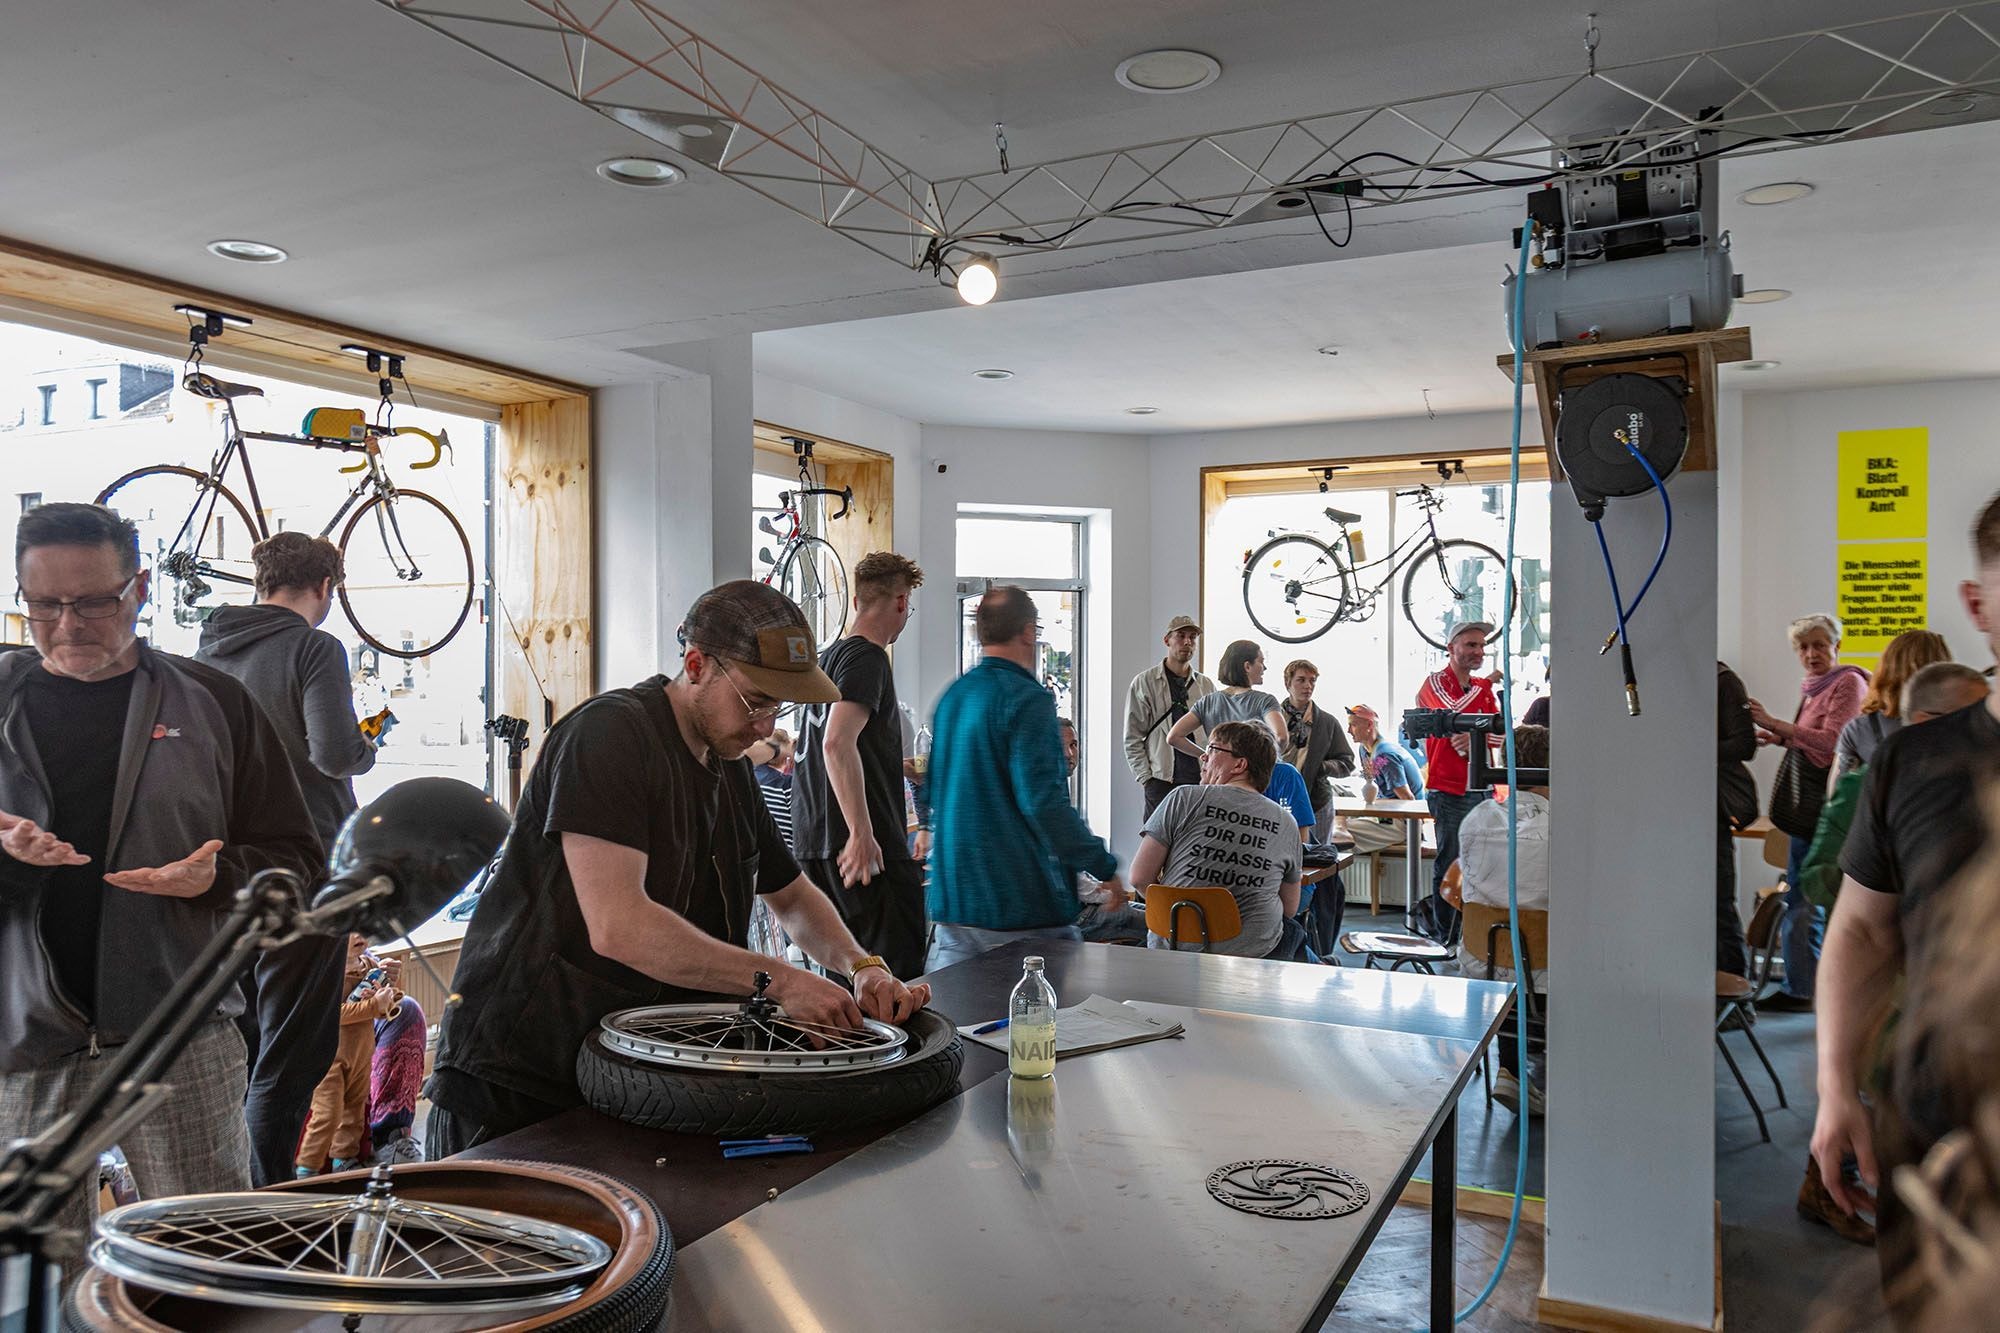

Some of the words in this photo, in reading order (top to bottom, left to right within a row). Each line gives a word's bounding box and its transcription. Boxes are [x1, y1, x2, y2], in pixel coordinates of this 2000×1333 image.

[1867, 457, 1899, 470] BKA:
[1867, 472, 1898, 484] Blatt
[1856, 485, 1909, 498] Kontroll
[1869, 501, 1896, 512] Amt
[1845, 561, 1860, 570] Die
[1862, 560, 1921, 569] Menschheit
[1842, 572, 1867, 581] stellt
[1870, 572, 1890, 580] sich
[1893, 571, 1923, 580] schon
[1853, 583, 1885, 592] immer
[1881, 594, 1897, 602] Die
[1847, 628, 1860, 637] ist
[1862, 628, 1880, 637] das
[1204, 804, 1281, 835] EROBERE
[1204, 826, 1236, 844] DIR
[1239, 832, 1268, 850] DIE
[1189, 844, 1273, 872] STRASSE
[1183, 863, 1265, 889] ZURÜCK!
